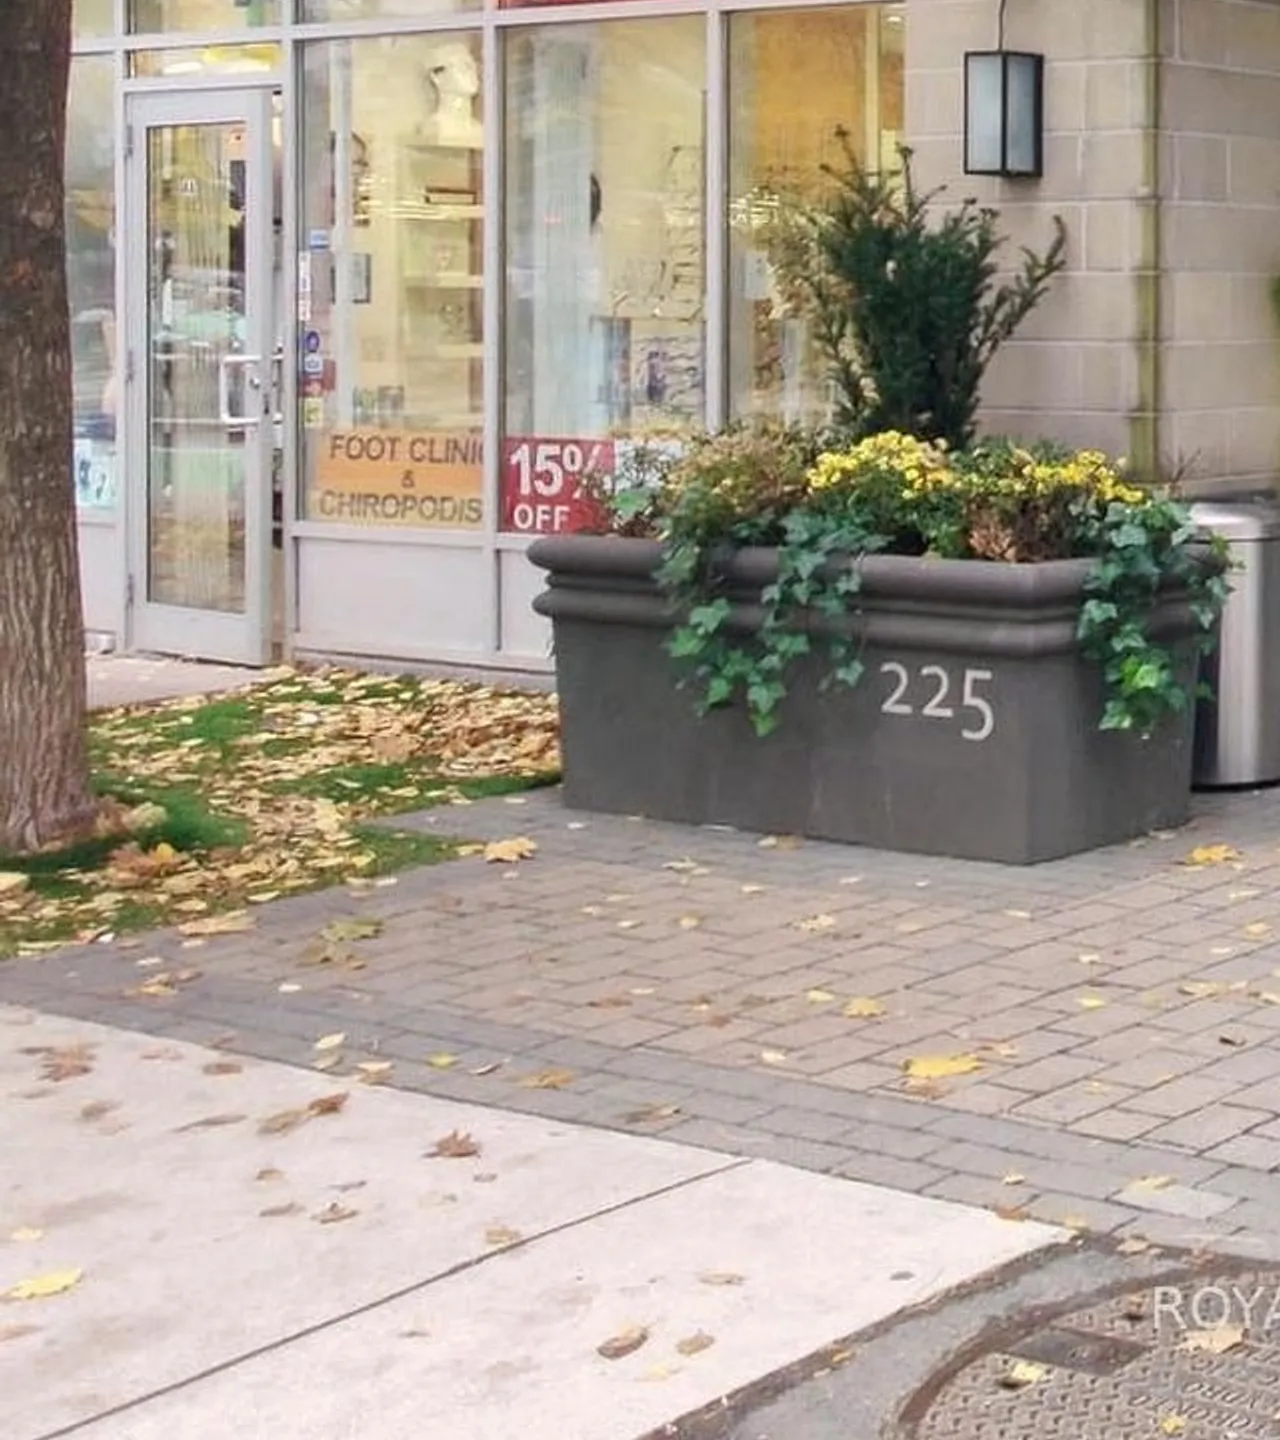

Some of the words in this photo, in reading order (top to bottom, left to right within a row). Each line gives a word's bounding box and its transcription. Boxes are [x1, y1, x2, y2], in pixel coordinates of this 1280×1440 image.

[330, 434, 402, 461] FOOT
[402, 469, 416, 489] &
[513, 504, 571, 531] OFF
[880, 661, 994, 741] 225
